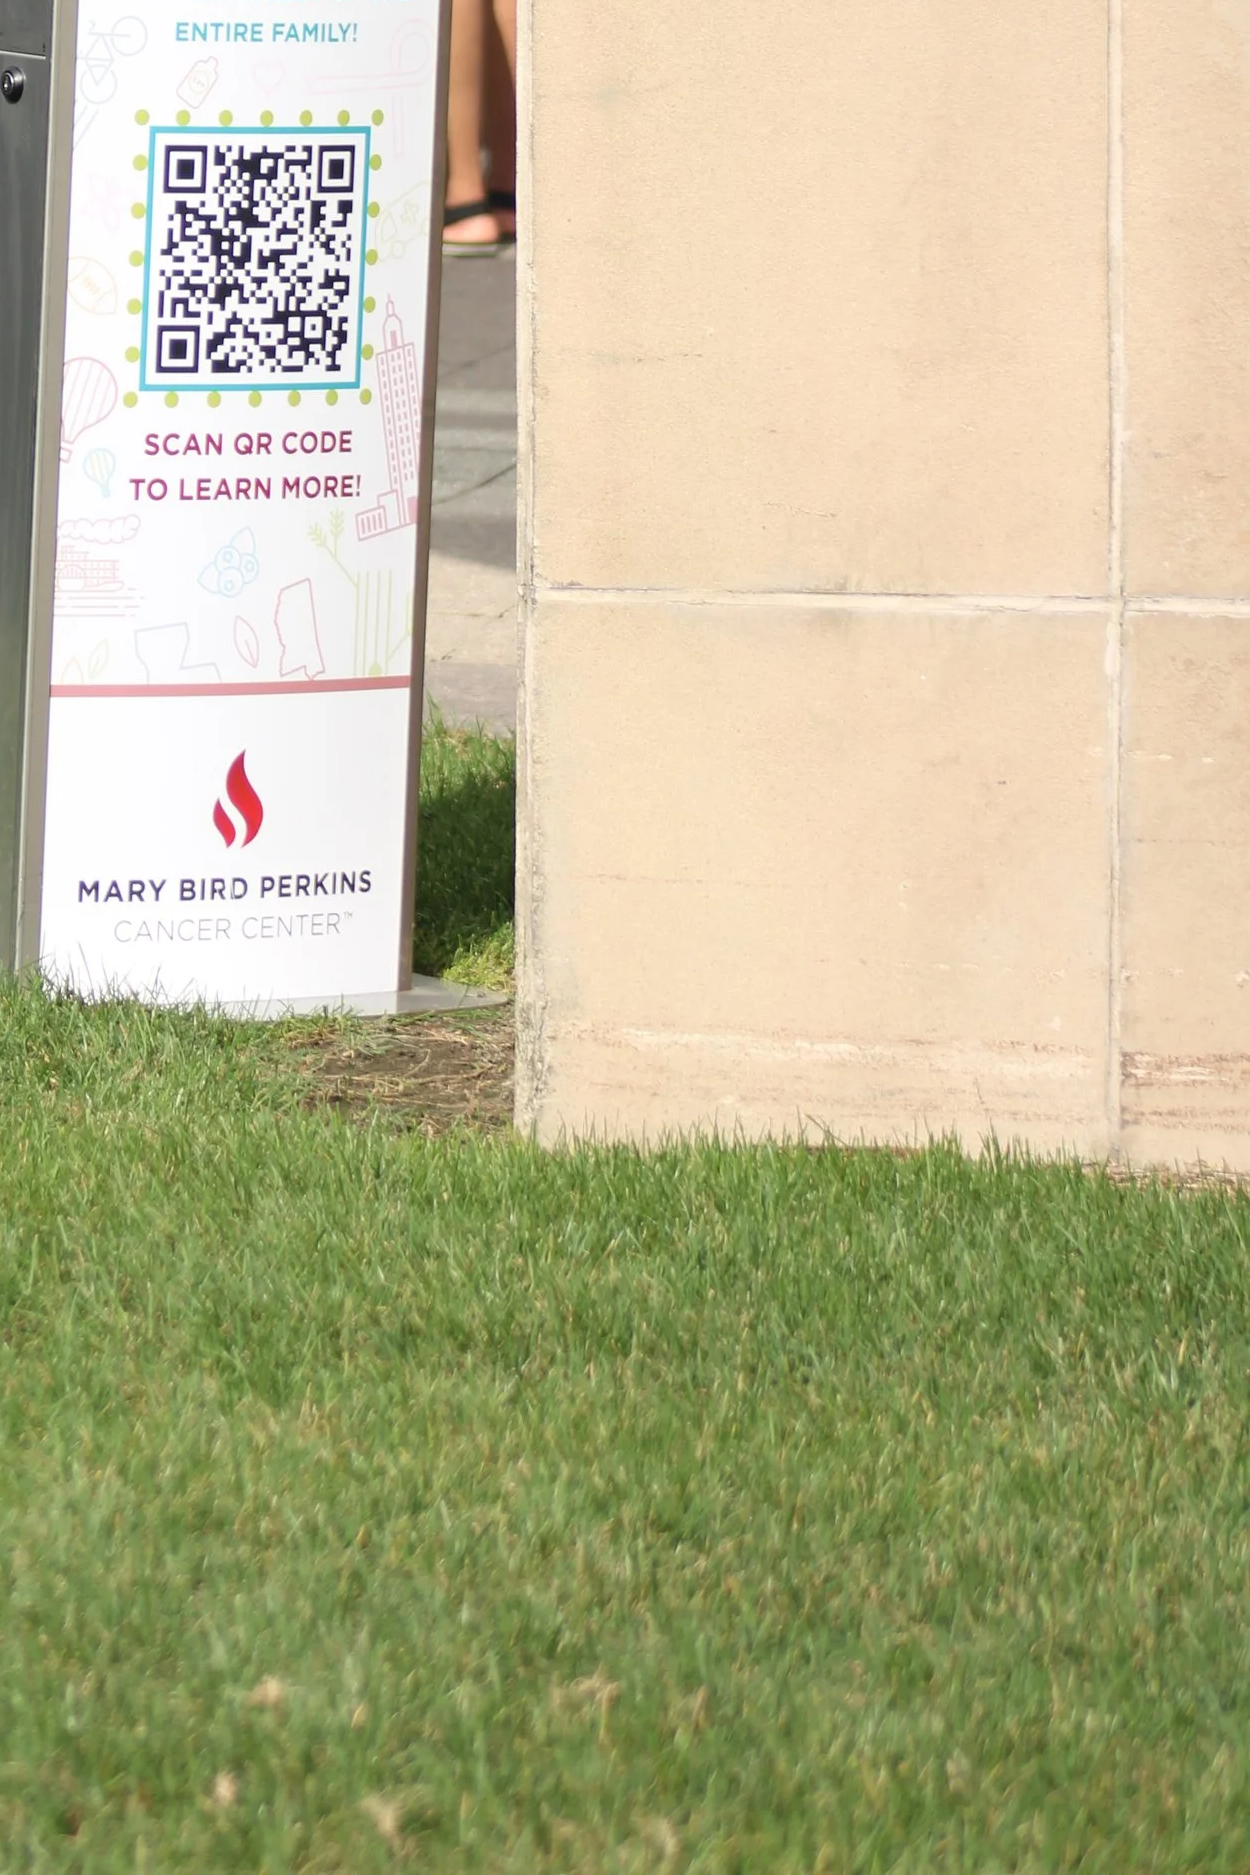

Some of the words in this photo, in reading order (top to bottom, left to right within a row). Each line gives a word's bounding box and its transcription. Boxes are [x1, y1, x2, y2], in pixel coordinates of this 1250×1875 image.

[174, 22, 264, 43] ENTIRE
[271, 22, 358, 43] FAMILY!
[144, 432, 223, 456] SCAN
[233, 432, 273, 456] QR
[281, 430, 353, 454] CODE
[129, 478, 168, 501] TO
[179, 477, 272, 501] LEARN
[281, 474, 361, 500] MORE!
[78, 879, 167, 904] MARY
[179, 877, 248, 902] BIRD
[259, 869, 372, 899] PERKINS
[113, 918, 232, 943] CANCER
